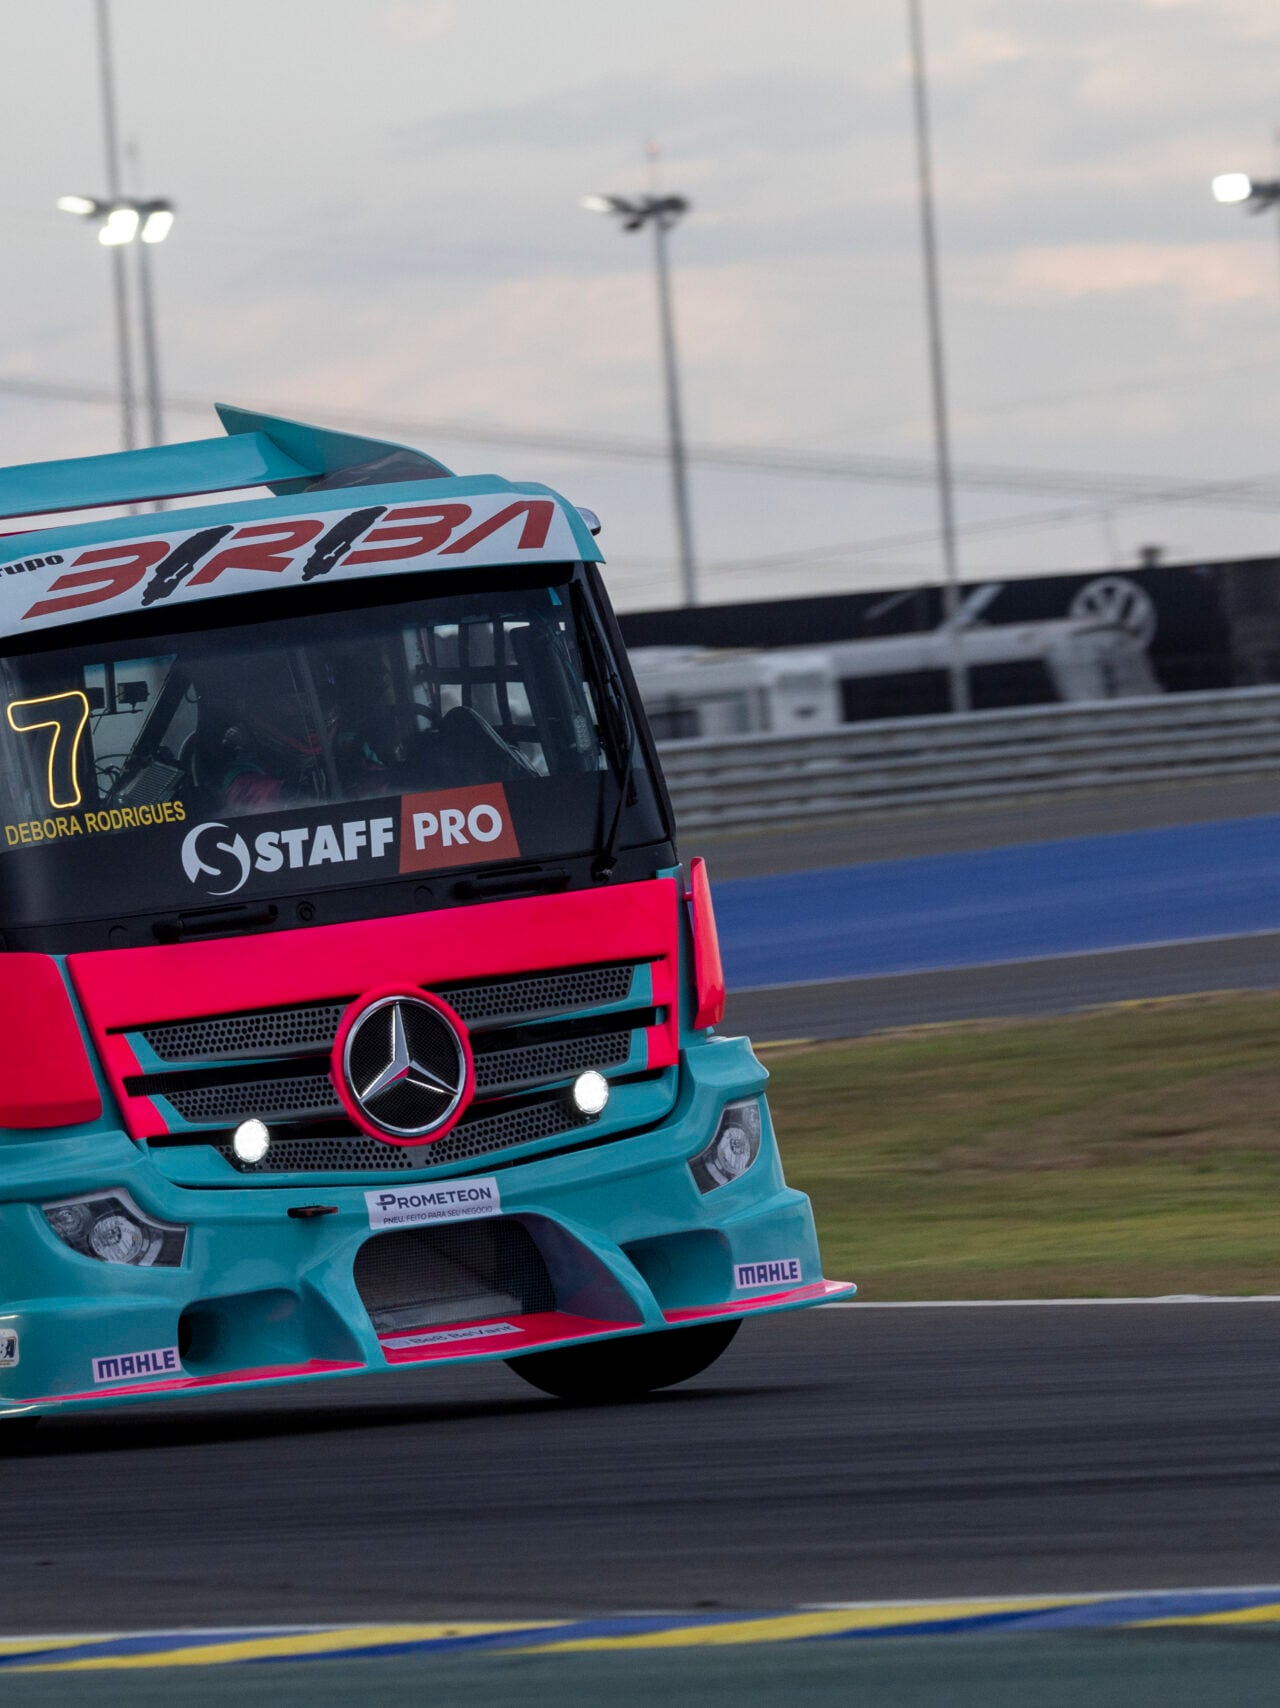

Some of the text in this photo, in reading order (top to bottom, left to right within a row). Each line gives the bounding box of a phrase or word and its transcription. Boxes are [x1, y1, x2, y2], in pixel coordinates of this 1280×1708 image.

[7, 690, 90, 809] 7
[4, 800, 187, 846] DEBORA RODRIGUES
[254, 816, 394, 873] STAFF
[412, 804, 503, 850] PRO
[376, 1187, 492, 1211] PROMETEON
[406, 1212, 426, 1222] FEITO
[427, 1210, 446, 1220] PARA
[447, 1209, 461, 1218] SEU
[738, 1261, 799, 1286] MAHLE
[97, 1350, 176, 1379] MAHLE
